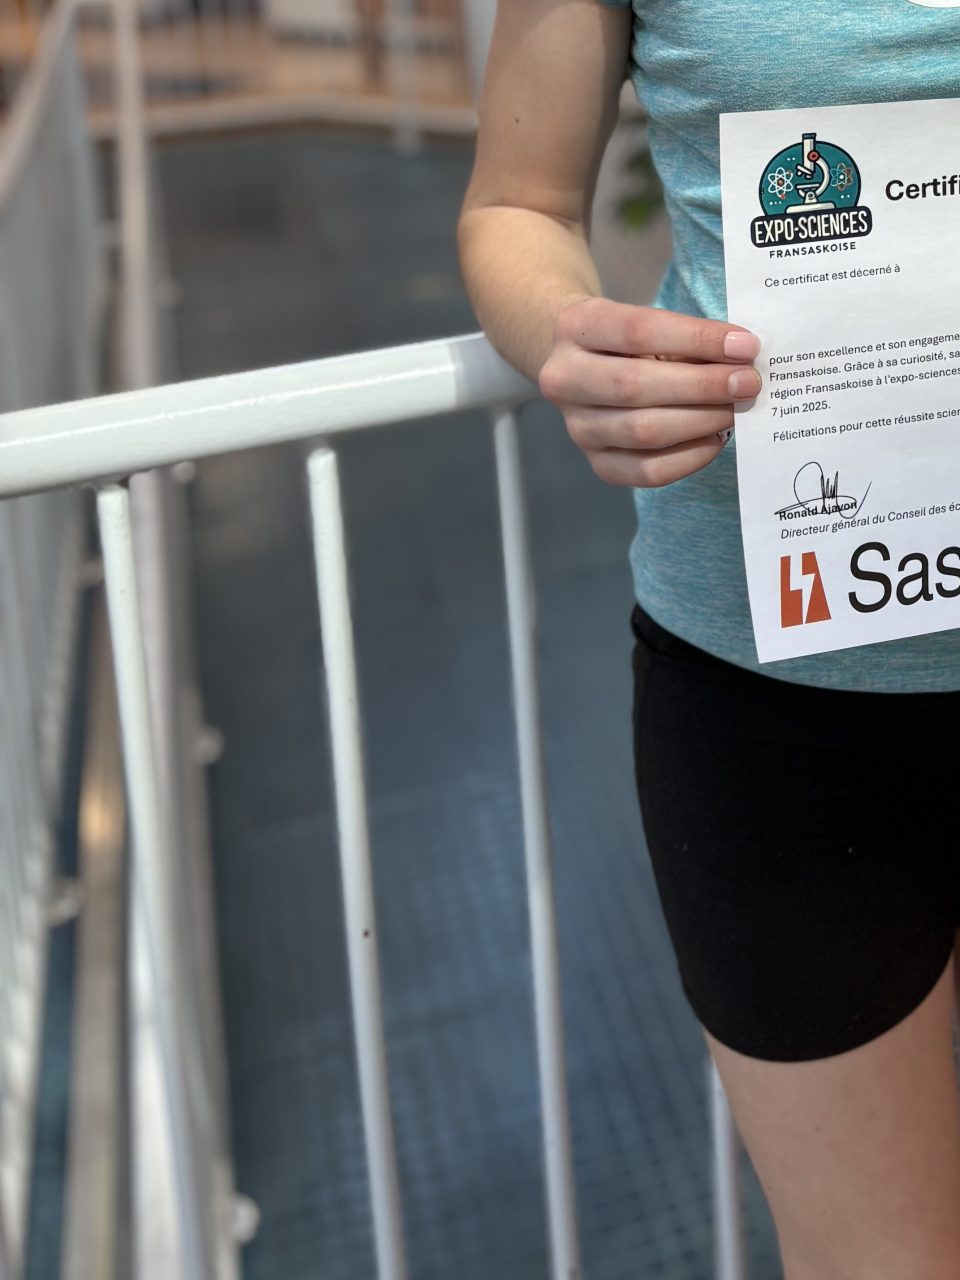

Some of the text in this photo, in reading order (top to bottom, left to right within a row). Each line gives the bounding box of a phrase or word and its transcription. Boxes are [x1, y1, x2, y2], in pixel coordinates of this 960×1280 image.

[755, 211, 868, 244] EXPO-SCIENCES
[769, 242, 857, 259] FRANSASKOISE
[764, 263, 900, 288] Ce certificat est décerné à
[769, 355, 794, 366] pour
[796, 352, 815, 361] son
[818, 345, 873, 358] excellence
[875, 342, 886, 352] et
[888, 340, 907, 349] son
[844, 360, 875, 372] Grâce
[877, 358, 884, 368] à
[886, 359, 898, 367] sa
[949, 350, 960, 359] sa
[770, 387, 803, 399] région
[805, 377, 873, 394] Fransaskoise
[875, 376, 882, 385] à
[771, 407, 778, 417] 7
[780, 405, 800, 418] juin
[773, 425, 837, 442] Félicitations
[839, 421, 863, 434] pour
[865, 418, 892, 429] cette
[894, 411, 935, 425] réussite
[780, 506, 818, 521] Ronald
[780, 524, 830, 539] Directeur
[831, 515, 870, 533] général
[872, 514, 886, 524] du
[887, 506, 927, 521] Conseil
[928, 501, 947, 515] des
